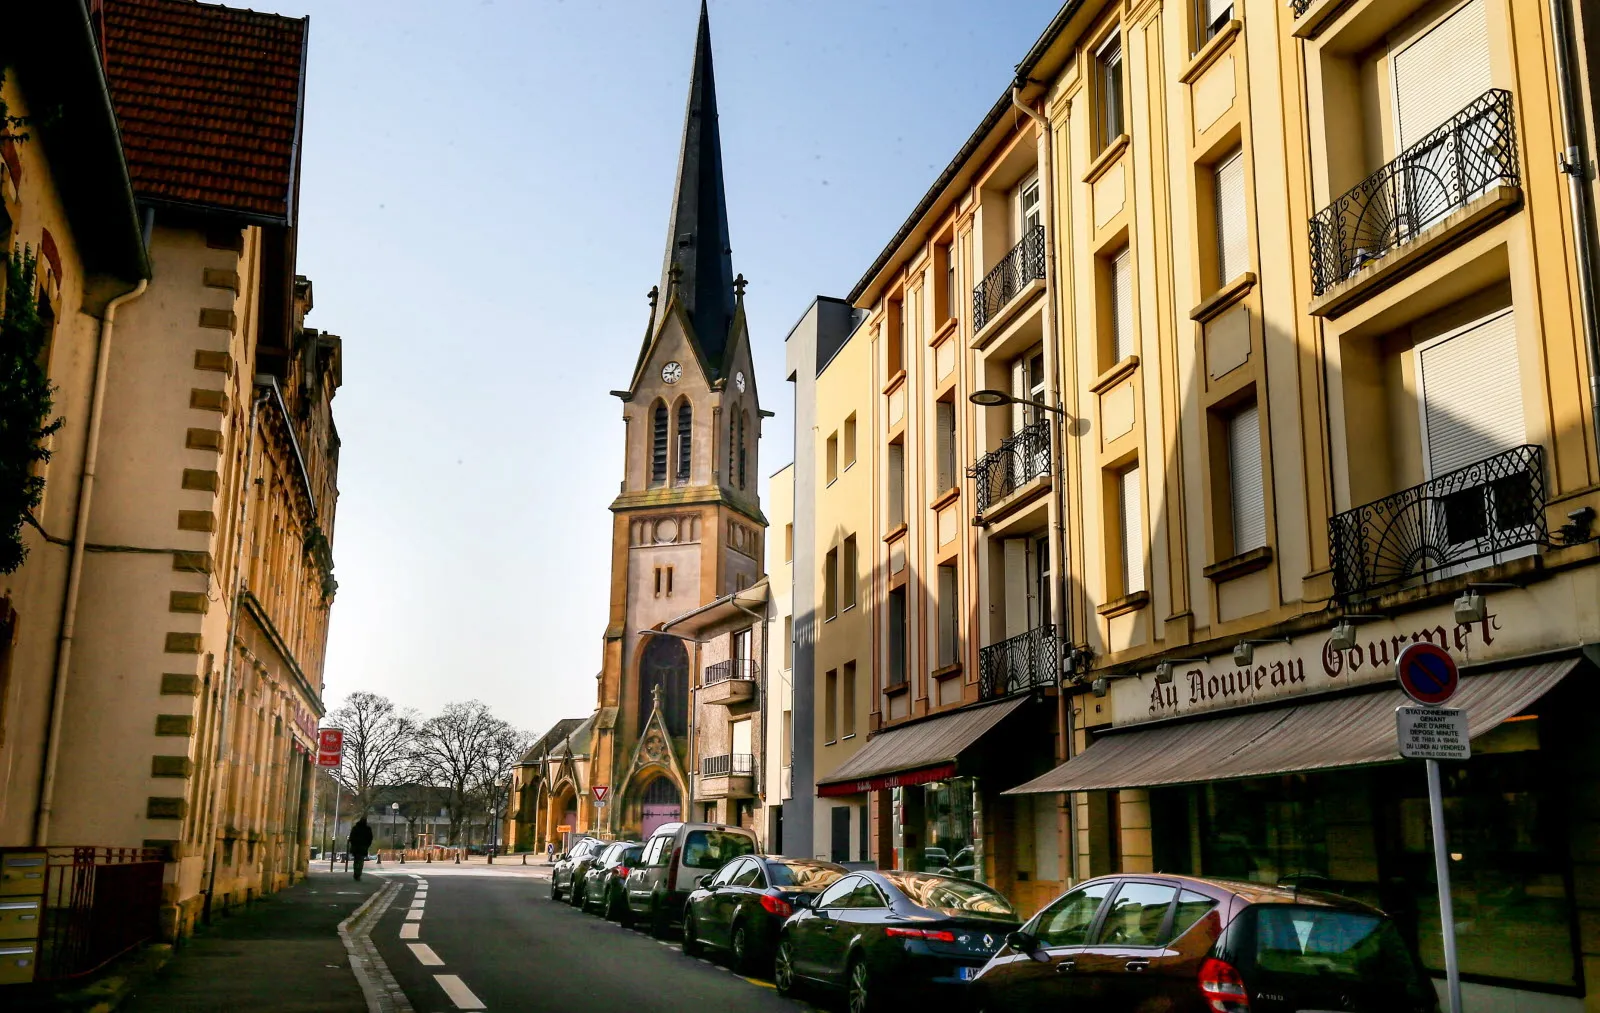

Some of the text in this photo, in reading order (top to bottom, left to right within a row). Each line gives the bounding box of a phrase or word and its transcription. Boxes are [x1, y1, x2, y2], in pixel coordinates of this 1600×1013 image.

[1148, 677, 1178, 715] Au
[1186, 656, 1306, 706] Nouveau
[1405, 708, 1460, 717] STATIONNEMENT
